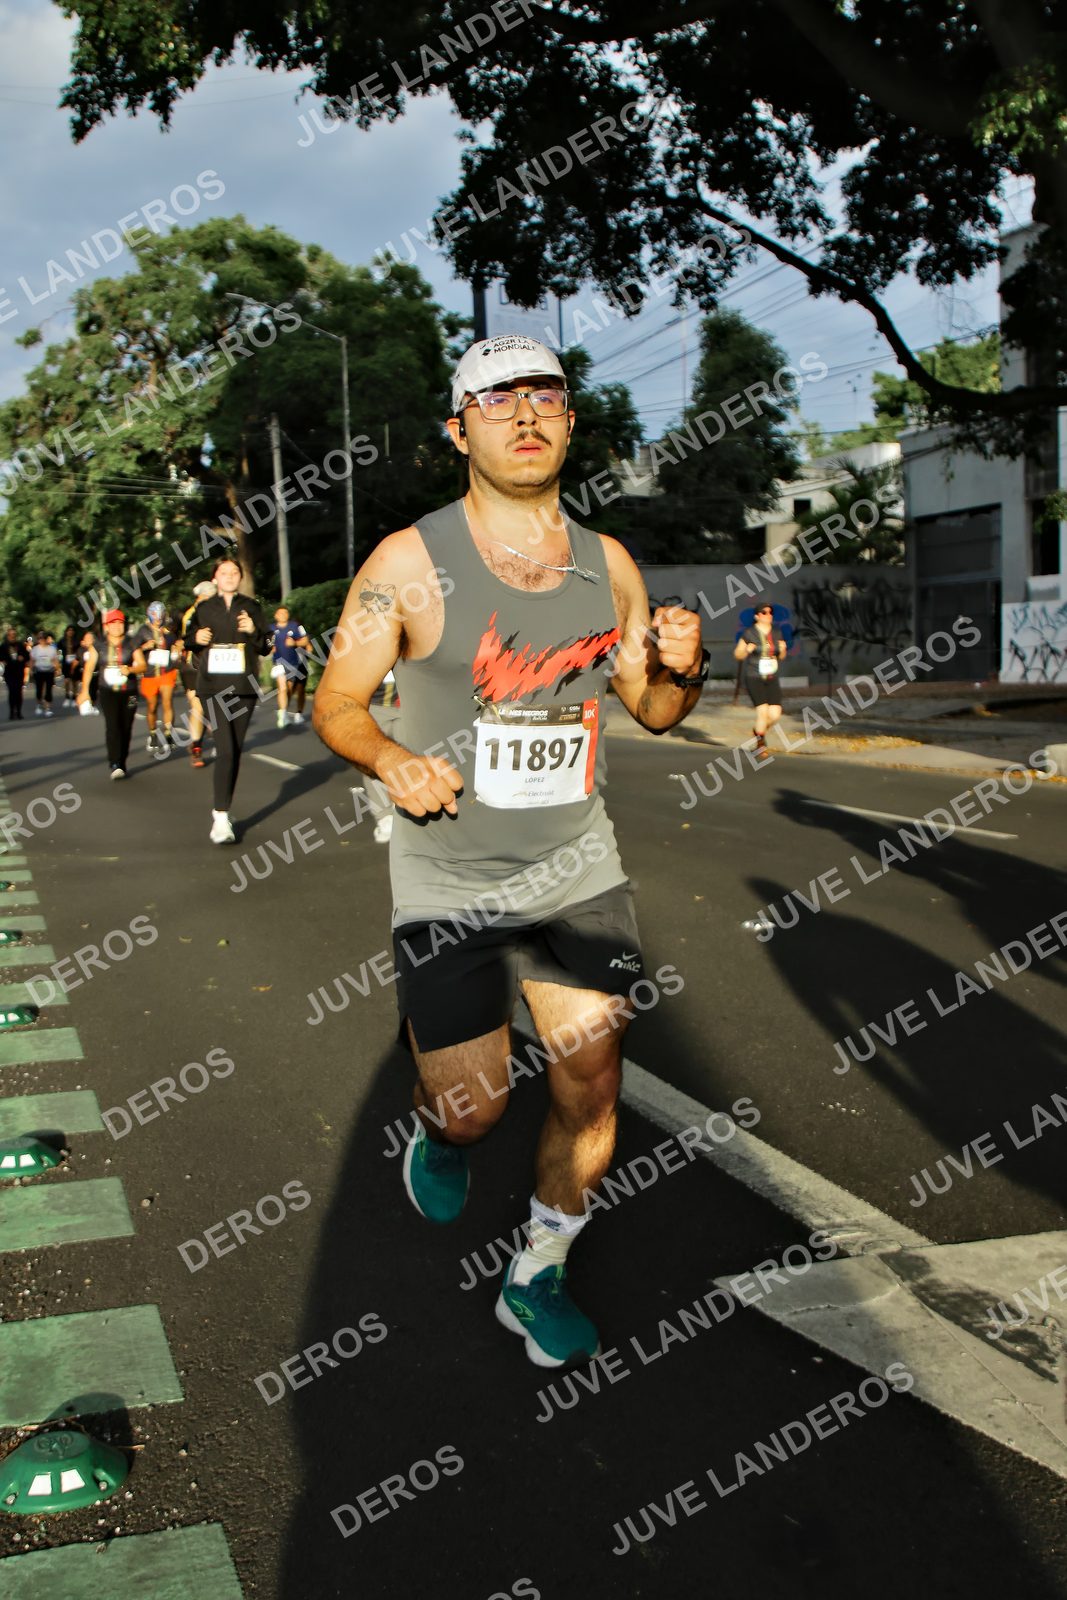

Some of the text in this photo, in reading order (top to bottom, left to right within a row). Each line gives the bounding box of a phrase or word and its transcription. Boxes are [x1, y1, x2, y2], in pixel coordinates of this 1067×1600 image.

[494, 343, 537, 354] MONDIALE
[498, 708, 522, 717] LENES
[485, 736, 584, 771] 11897
